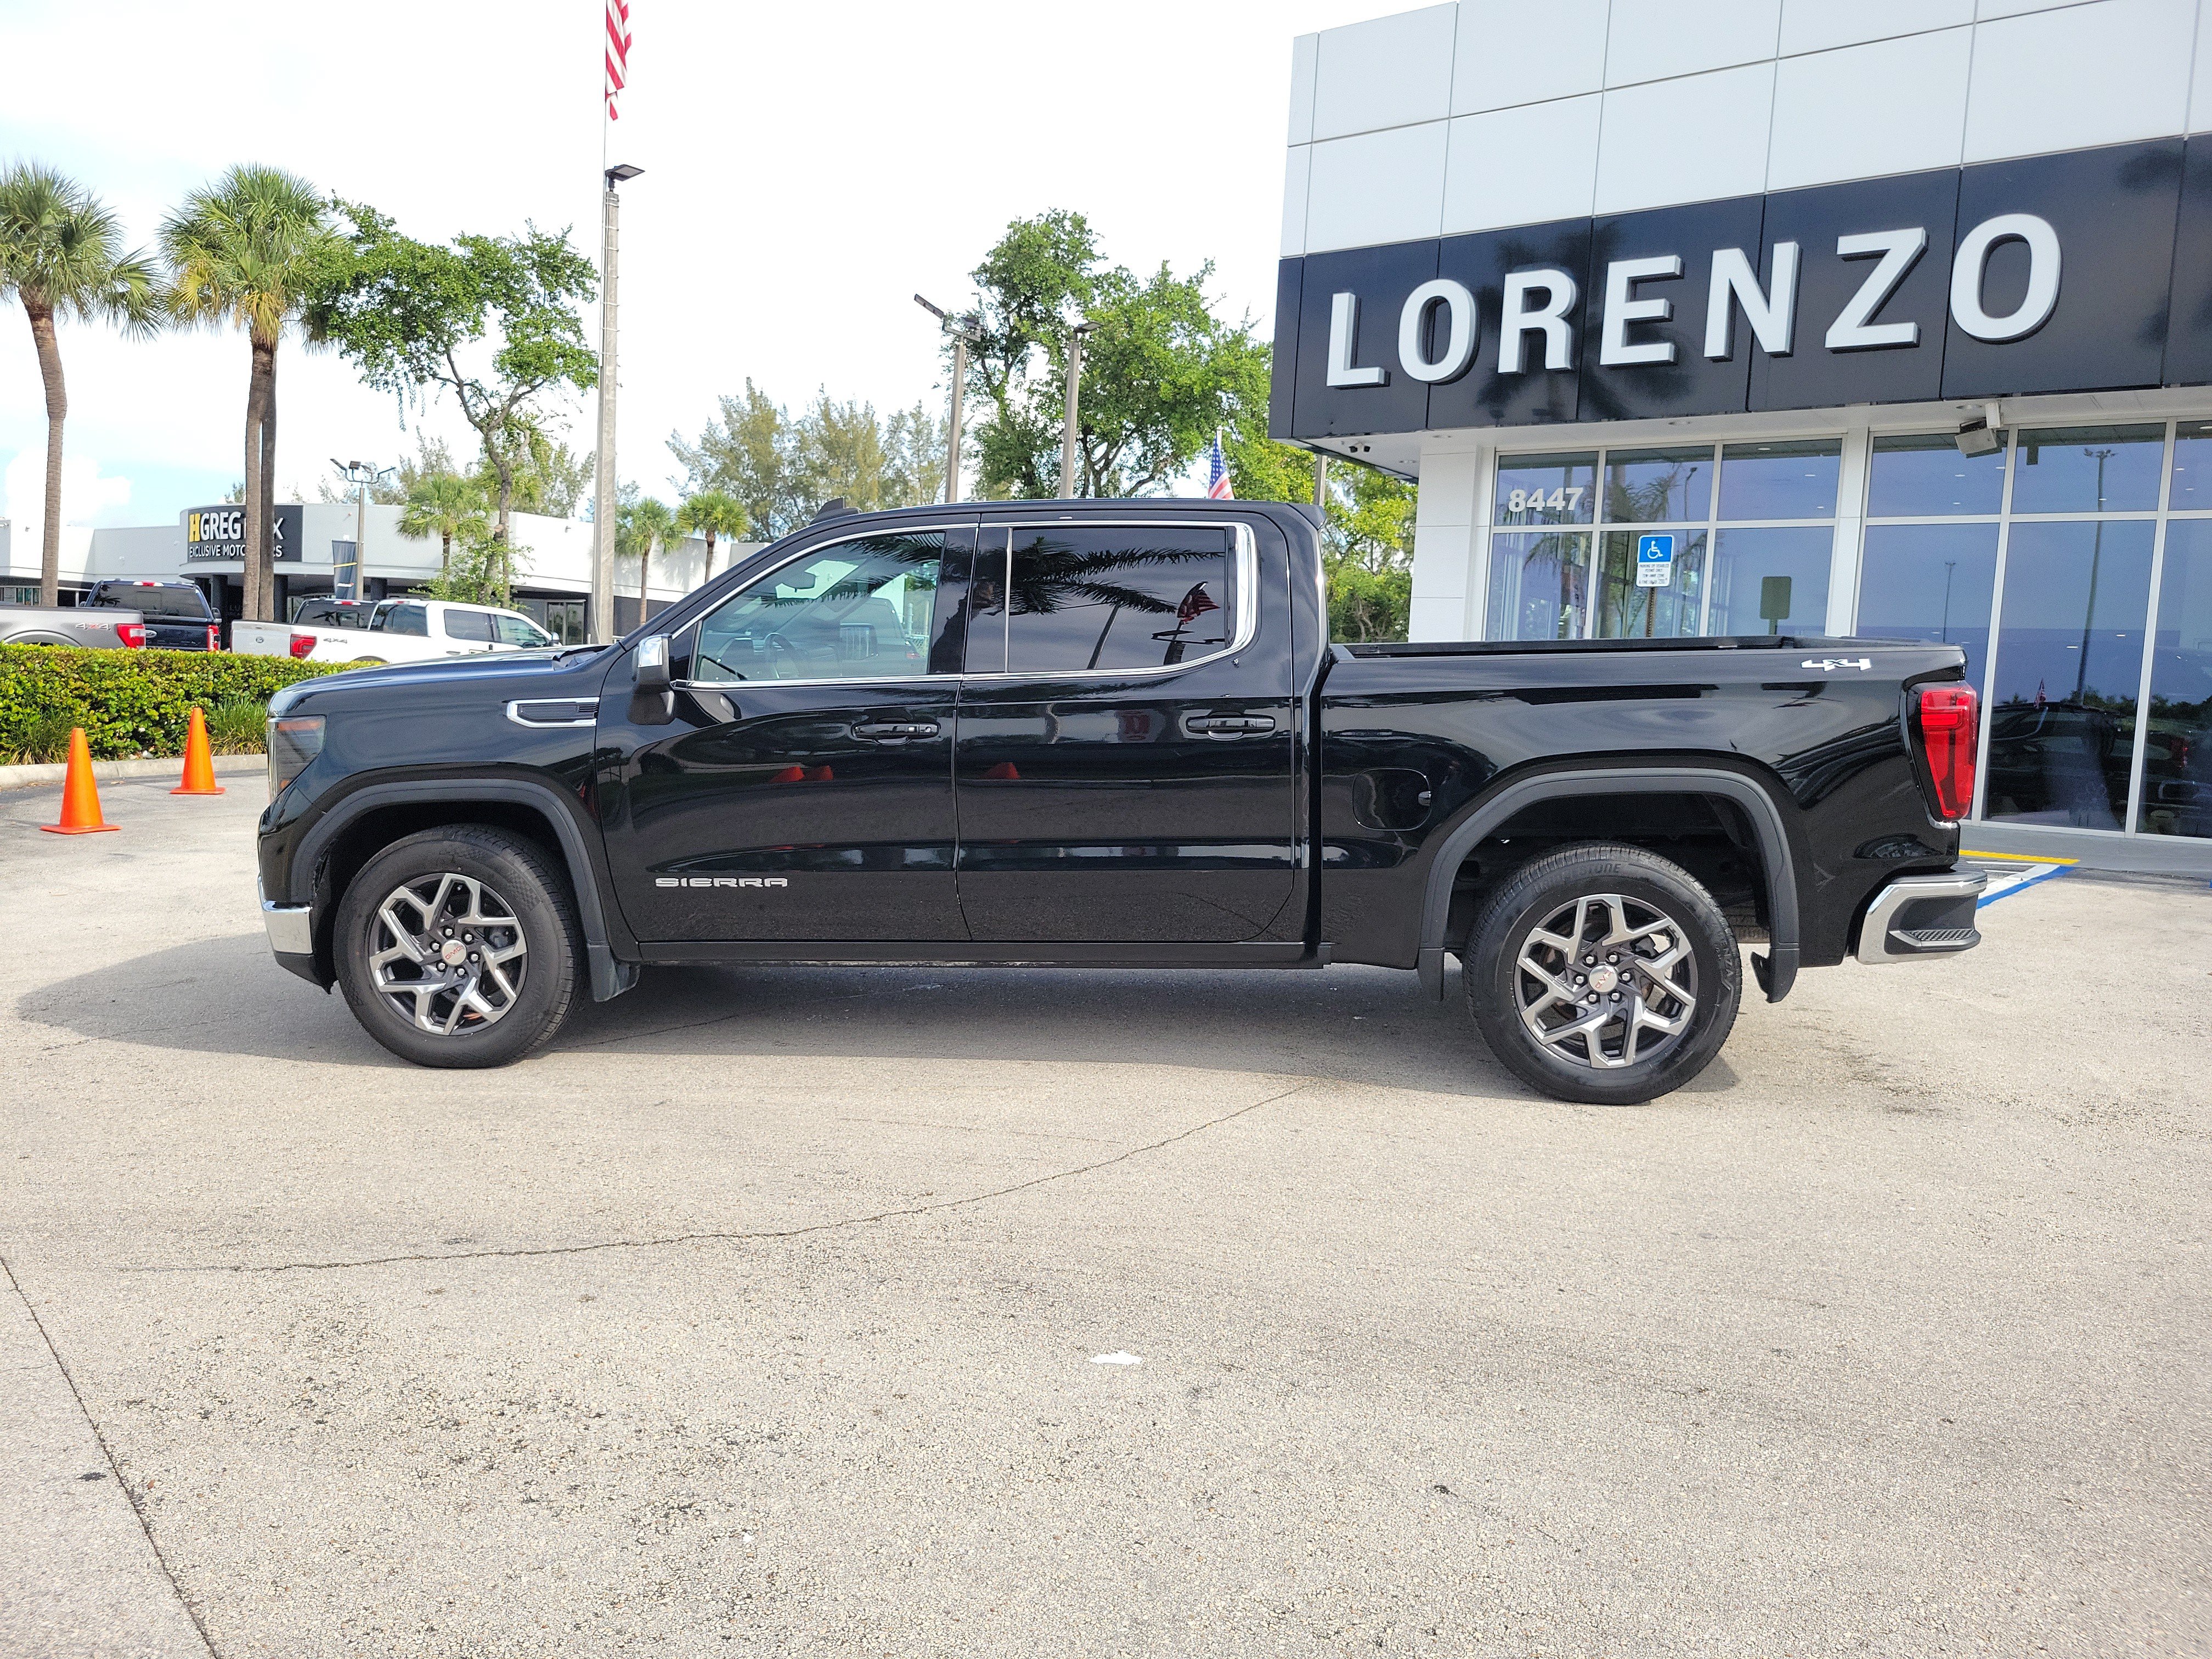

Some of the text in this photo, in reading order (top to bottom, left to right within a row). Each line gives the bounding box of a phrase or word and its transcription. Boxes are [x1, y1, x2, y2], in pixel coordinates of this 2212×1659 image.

[1326, 212, 2062, 387] LORENZO
[1508, 487, 1584, 512] 8447
[189, 511, 241, 542] HGREG
[190, 544, 221, 557] EXCLUSIVE
[655, 878, 788, 888] SIERRA
[445, 945, 463, 960] GMC
